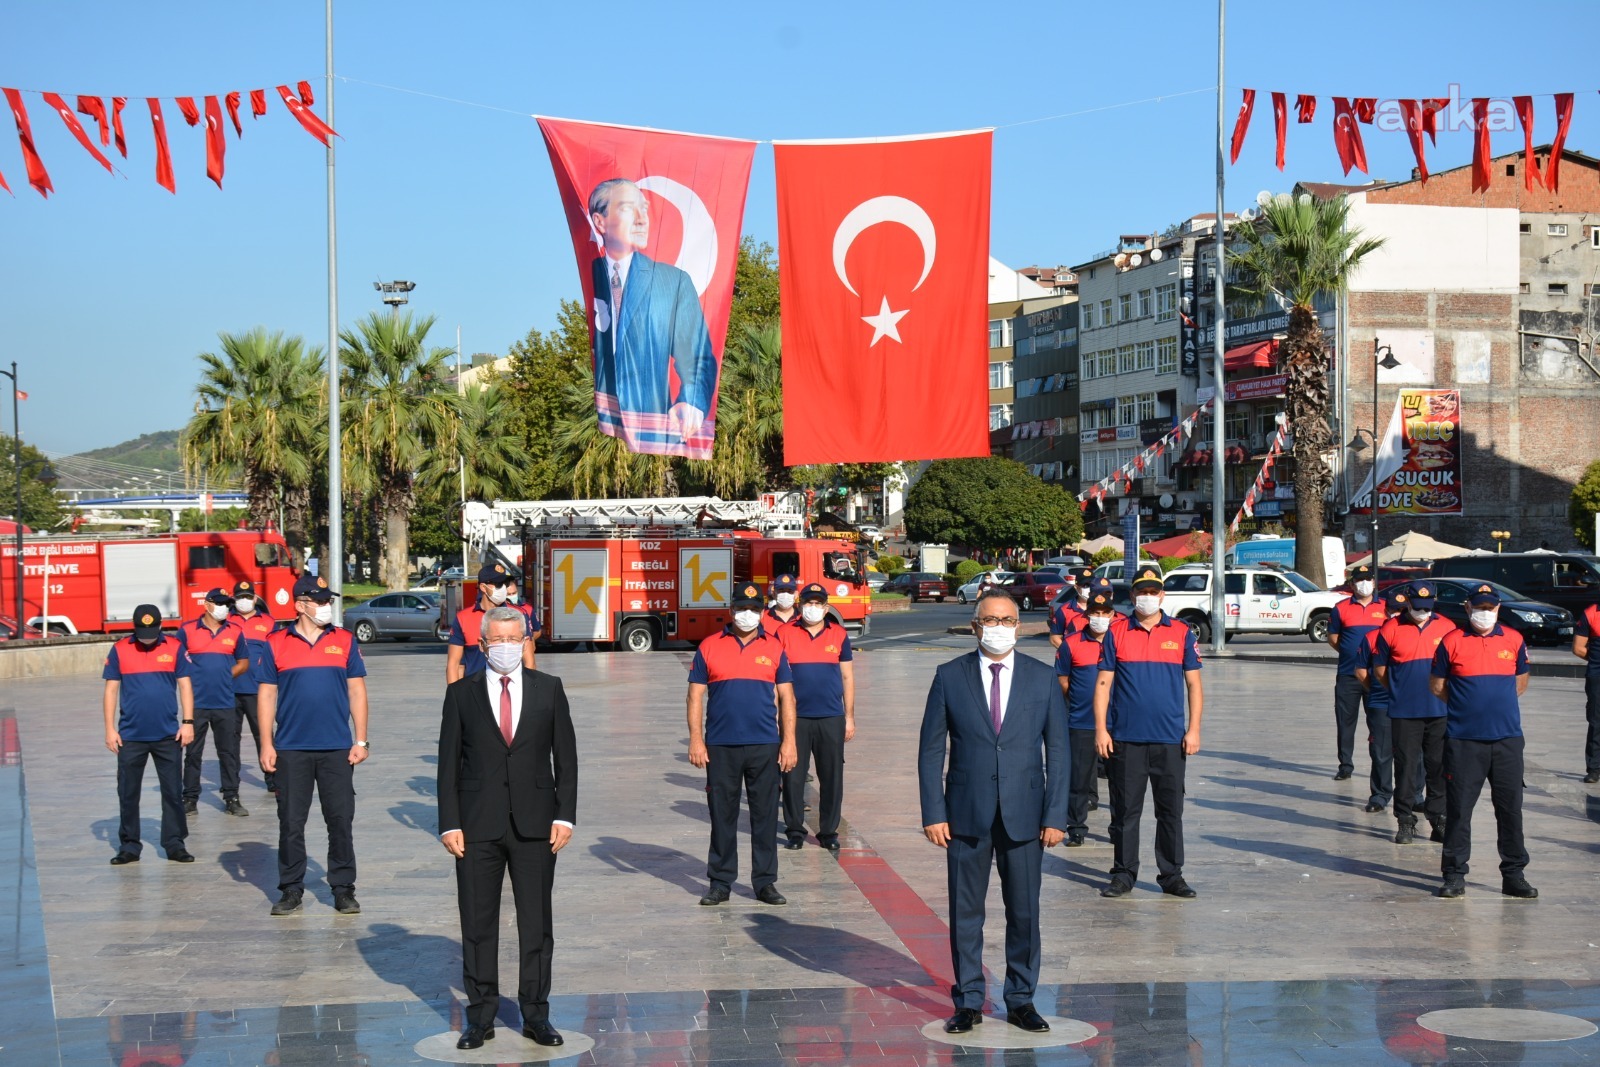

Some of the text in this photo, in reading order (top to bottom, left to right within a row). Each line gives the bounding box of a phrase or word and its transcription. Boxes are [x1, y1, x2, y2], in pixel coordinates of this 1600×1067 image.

[1394, 470, 1455, 486] SUCUK
[1354, 492, 1413, 508] MDYE
[640, 541, 661, 550] KDZ
[631, 560, 669, 570] EREĞLİ
[625, 579, 675, 590] İTFAİYESİ
[646, 599, 669, 609] 112
